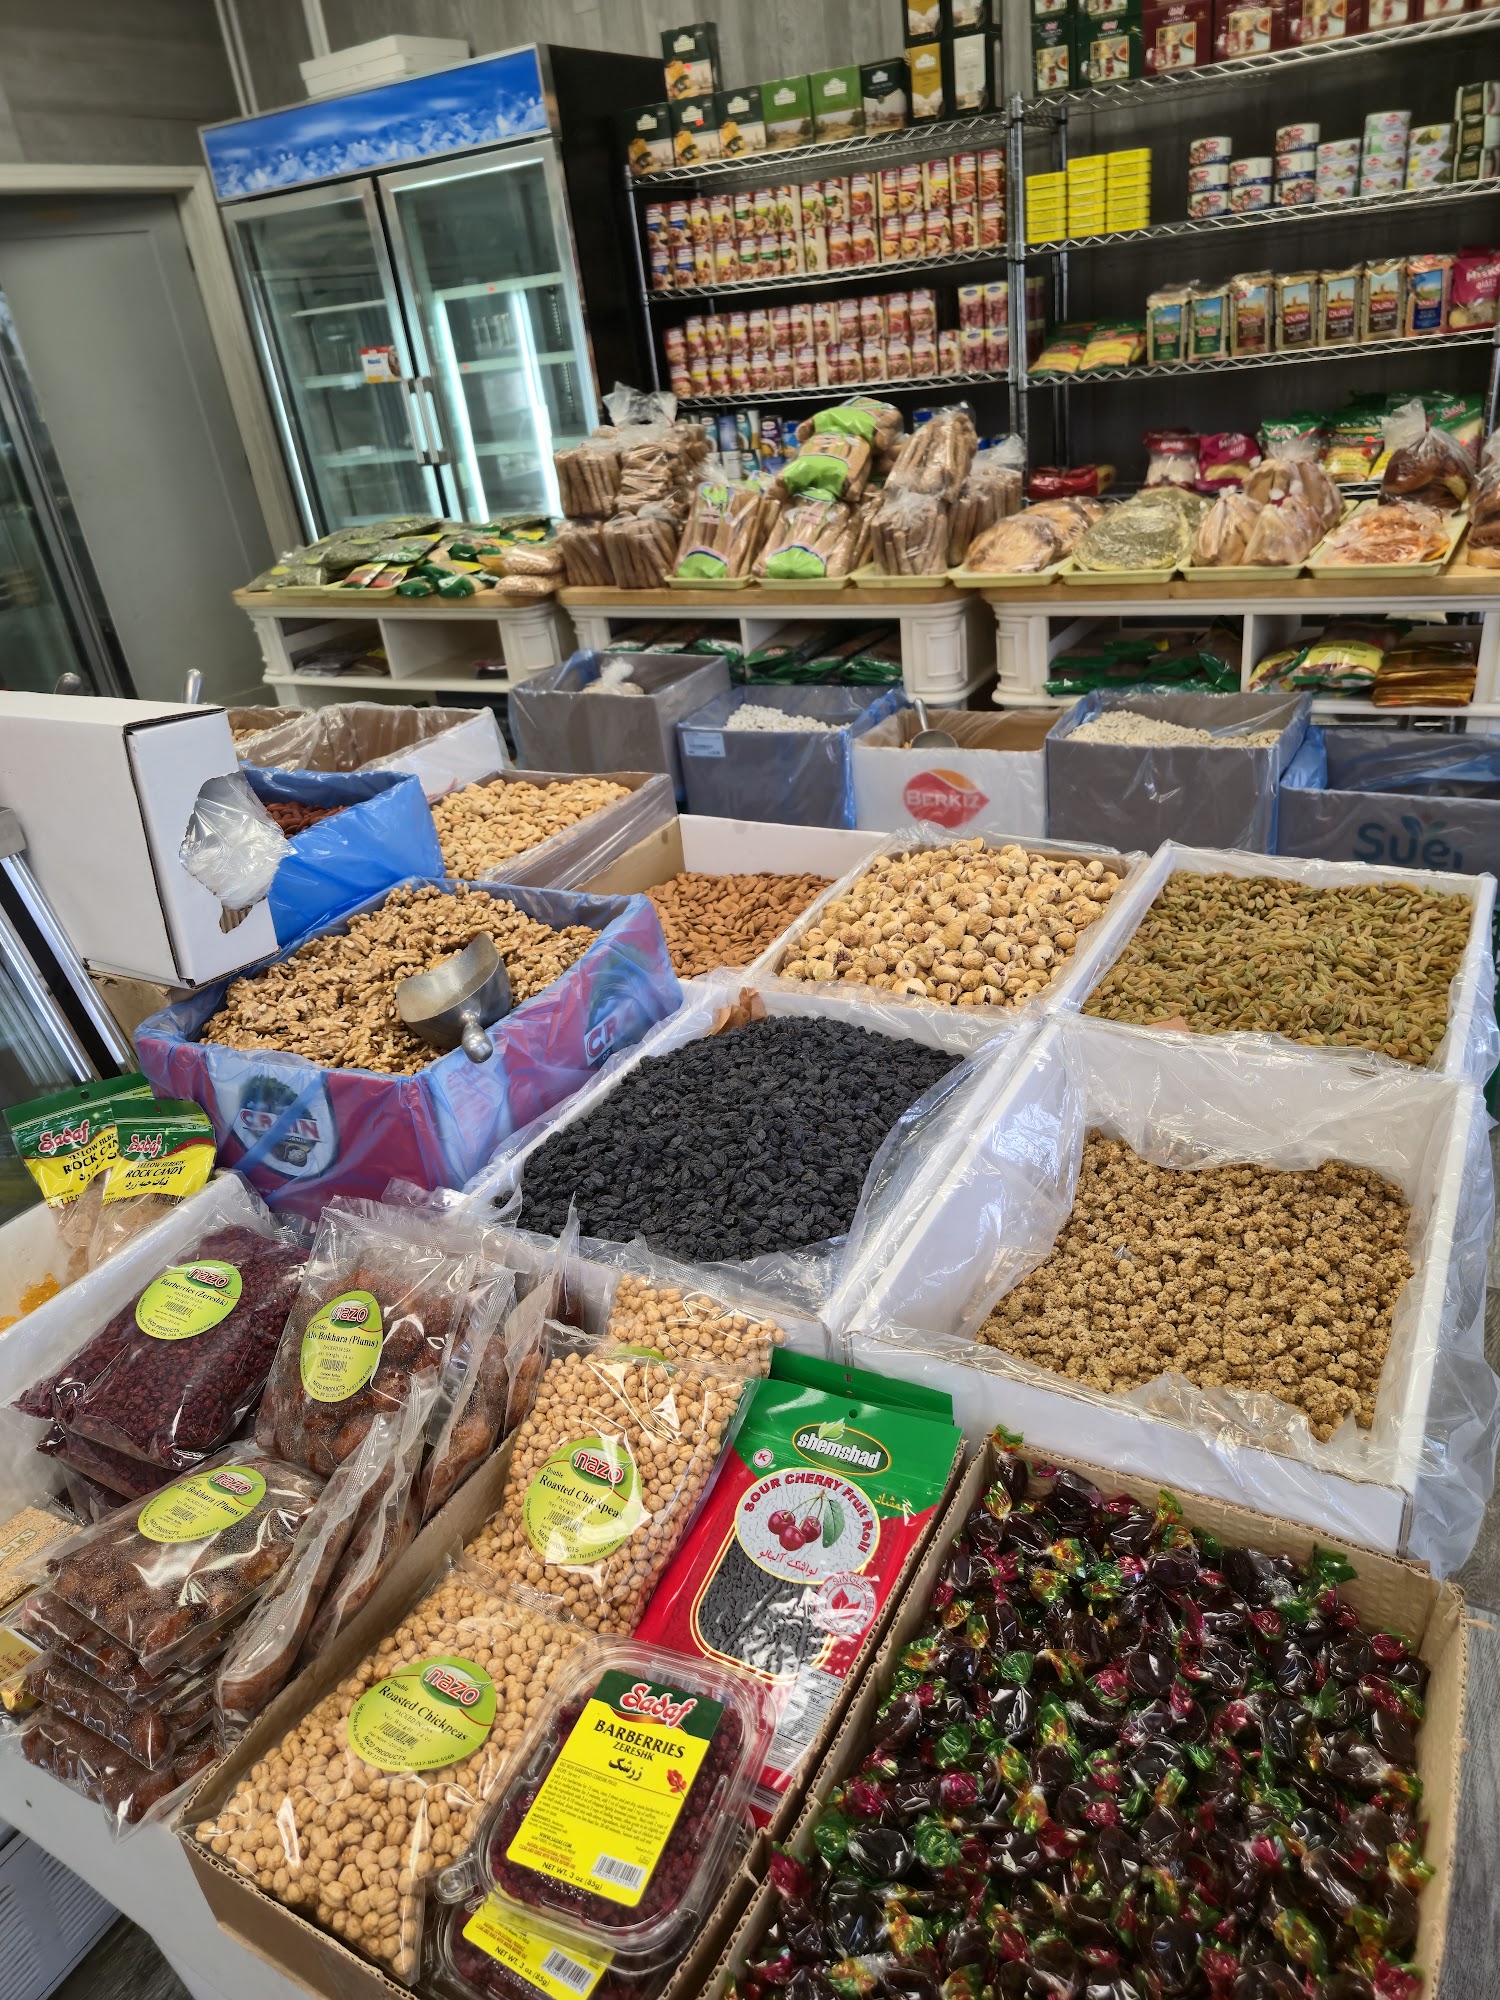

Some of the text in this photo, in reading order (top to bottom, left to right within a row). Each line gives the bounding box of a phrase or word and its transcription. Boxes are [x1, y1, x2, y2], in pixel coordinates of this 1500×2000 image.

[38, 1119, 90, 1152] Sadaf
[127, 1133, 163, 1157] Sadaf
[63, 1153, 98, 1175] ROCK
[153, 1166, 186, 1176] CANDY
[161, 1279, 195, 1294] Barberries
[188, 1268, 229, 1288] nazo
[318, 1331, 348, 1343] Bokhara
[797, 1433, 882, 1470] shemshad
[546, 1466, 563, 1478] Double
[574, 1451, 624, 1483] nazo
[211, 1471, 252, 1495] nazo
[539, 1474, 624, 1520] Roasted Chickpeas
[743, 1473, 874, 1554] SOUR CHERRY Fruit Roll
[832, 1574, 868, 1588] SINGLE
[390, 1679, 409, 1692] Double
[425, 1667, 480, 1705] nazo
[378, 1685, 468, 1741] Roasted Chickpeas
[393, 1709, 417, 1724] PACKED
[620, 1683, 698, 1728] Sadaf
[363, 1735, 407, 1761] NAZO PRODUCTS
[594, 1719, 685, 1759] BARBERRIES
[612, 1741, 655, 1762] ZERESHK
[608, 1758, 644, 1782] زرشک
[542, 1862, 555, 1871] NET
[556, 1866, 568, 1876] WT.
[584, 1878, 603, 1891] (85g)
[495, 1945, 508, 1958] NET
[532, 1971, 550, 1988] (85g)
